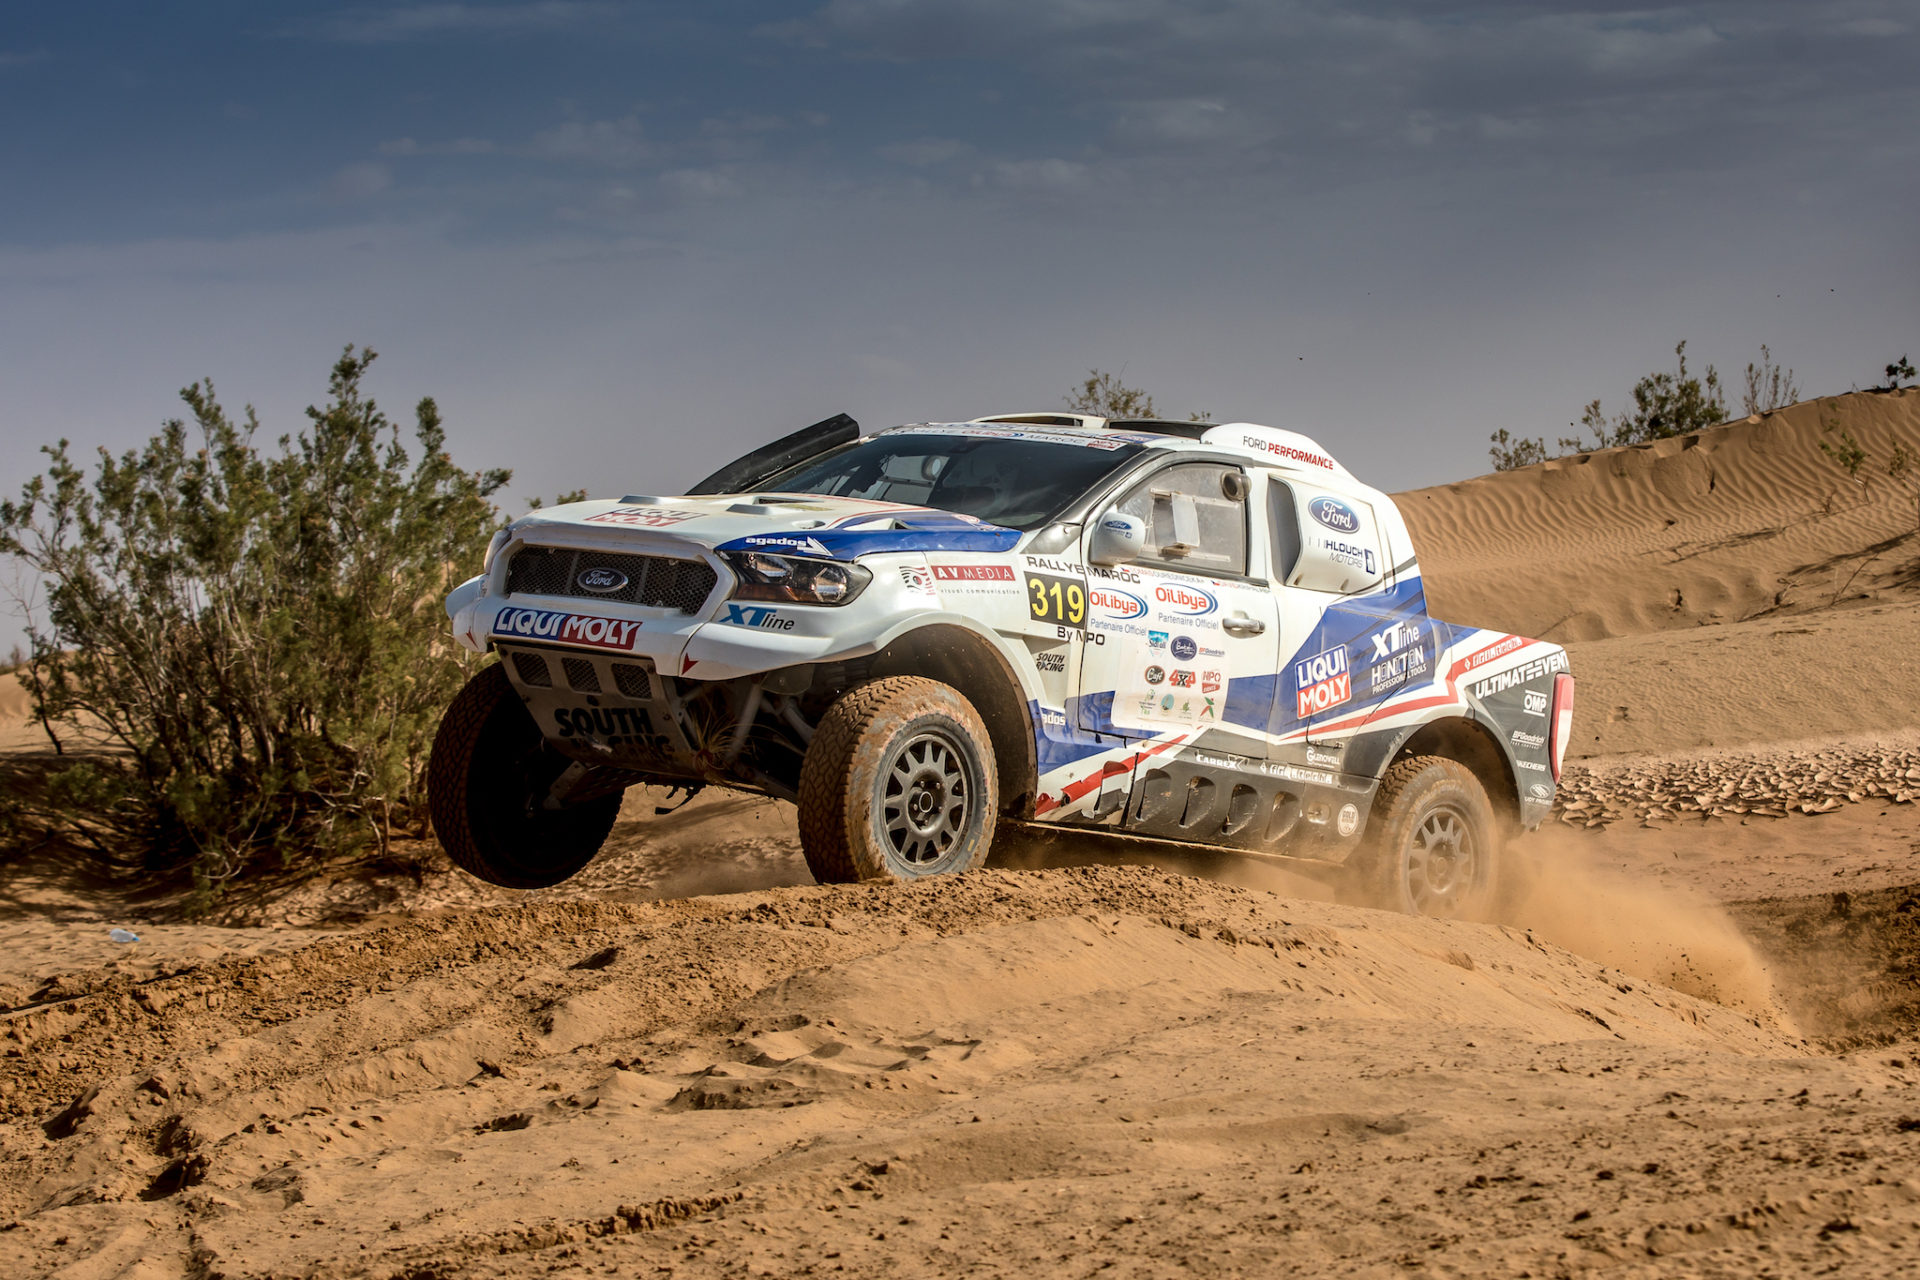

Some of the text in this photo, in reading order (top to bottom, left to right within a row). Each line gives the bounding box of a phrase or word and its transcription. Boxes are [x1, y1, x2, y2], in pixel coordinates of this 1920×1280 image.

[1243, 435, 1334, 471] FORD PERFORMANCE
[587, 513, 686, 527] MOLY
[1321, 500, 1353, 529] Ford
[745, 537, 808, 548] agados
[1325, 539, 1363, 558] HLOUCH
[1328, 552, 1363, 568] MOTORS
[585, 569, 616, 586] Ford
[937, 567, 1014, 580] AV MEDIA
[1026, 556, 1085, 575] RALLYE
[1086, 566, 1141, 585] MAROC
[1029, 578, 1085, 624] 319
[1089, 591, 1138, 614] OiLibya
[1155, 587, 1207, 610] OiLibya
[496, 608, 641, 646] LIQUI MOLY
[719, 603, 795, 631] XTline
[1090, 618, 1147, 636] Partenaire Officiel
[1158, 612, 1219, 630] Partenaire Officiel
[1057, 626, 1106, 646] By NPO
[1370, 621, 1420, 663] XTline
[1036, 652, 1066, 663] SOUTH
[1297, 647, 1346, 688] LIQUI
[1202, 670, 1221, 682] NPO
[1410, 663, 1427, 678] TOOLS
[1299, 674, 1349, 715] MOLY
[1524, 694, 1547, 713] OMP
[554, 707, 655, 737] SOUTH
